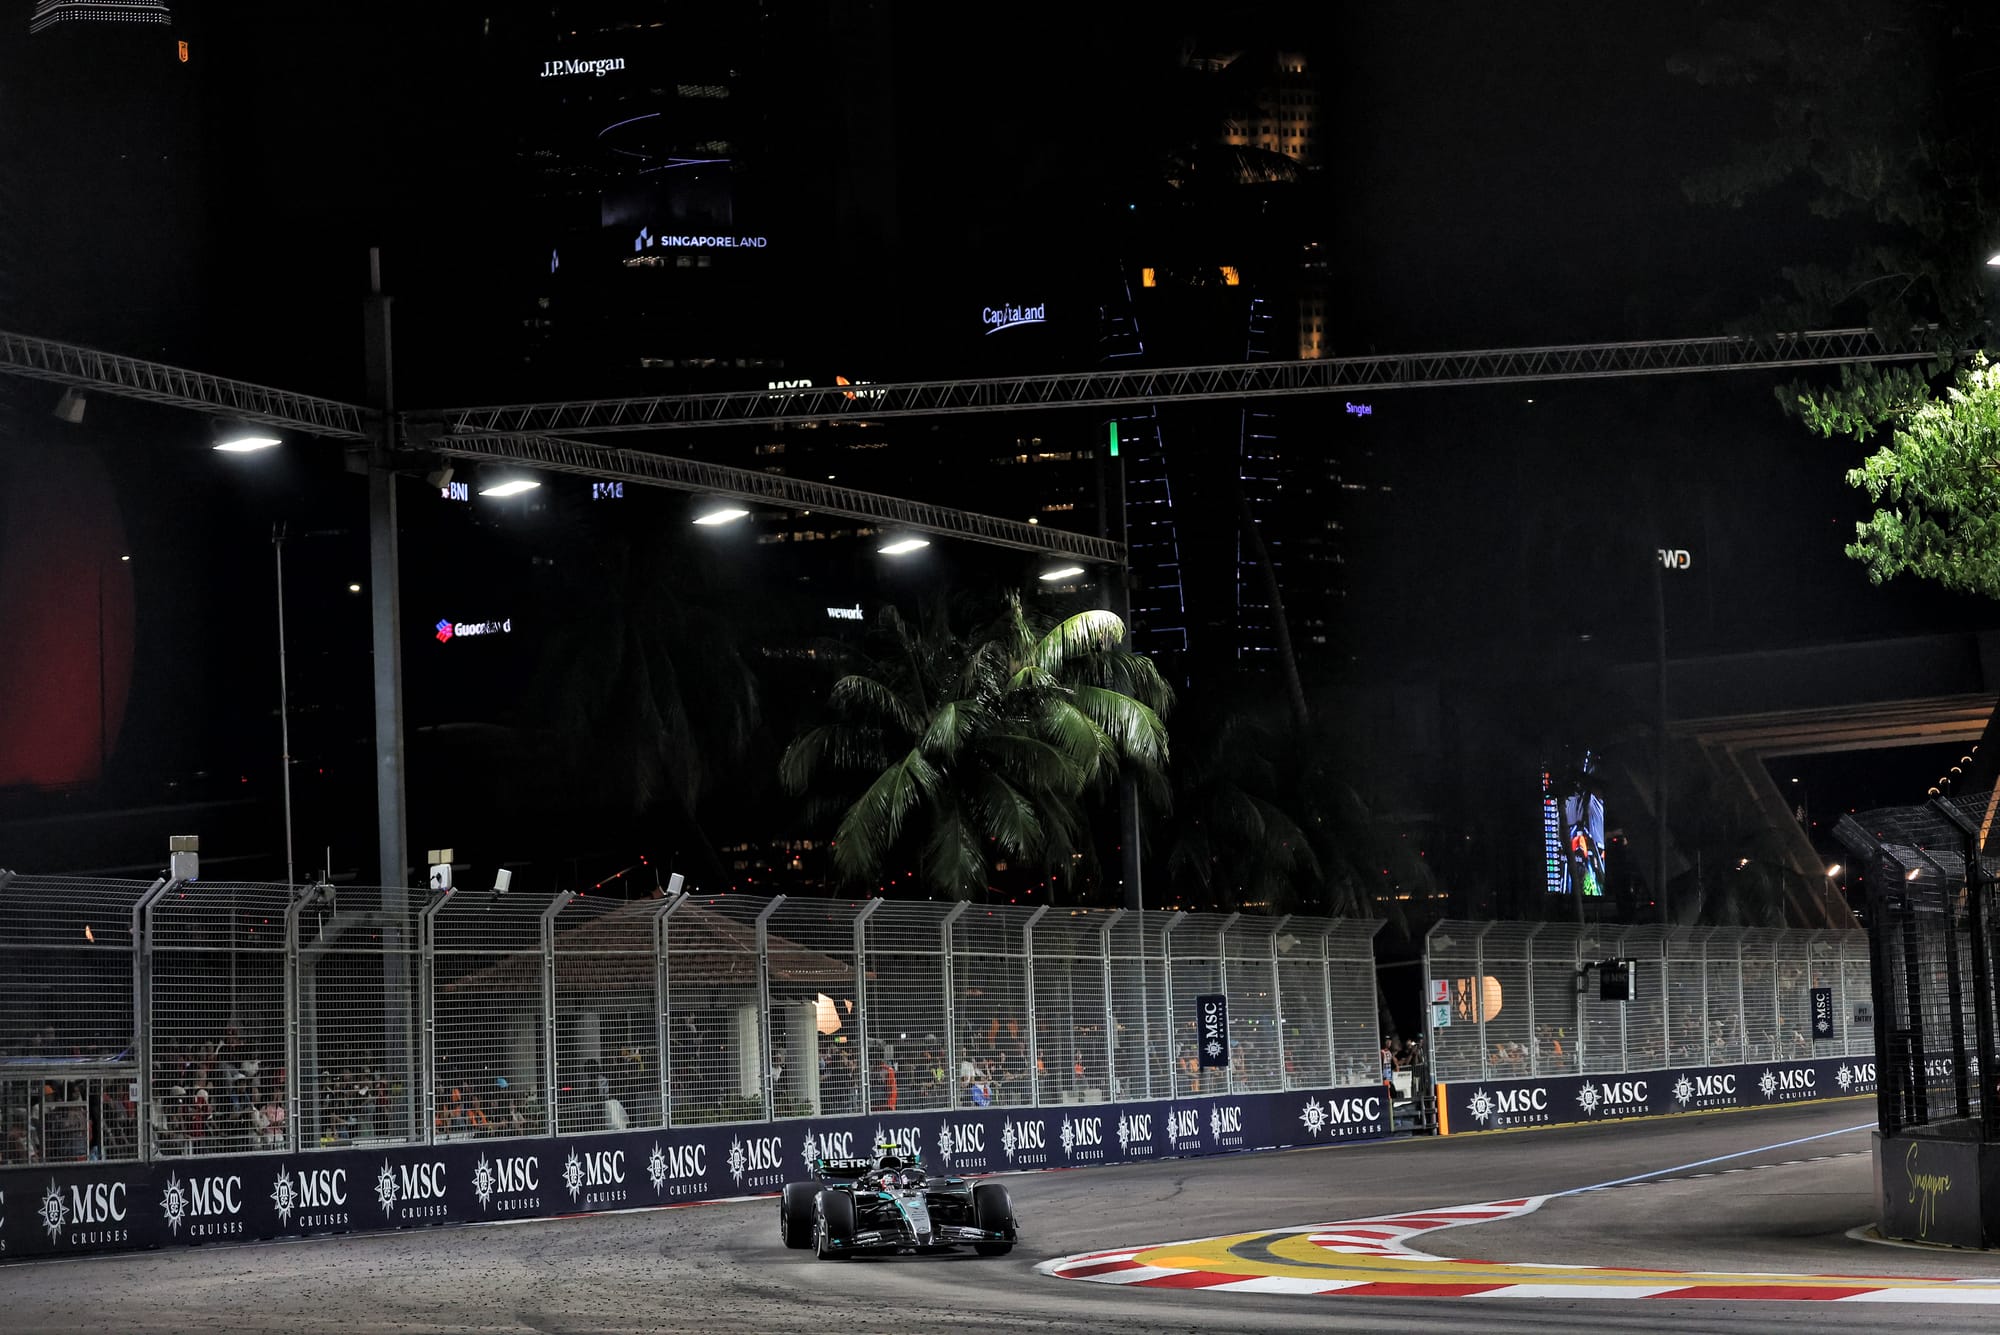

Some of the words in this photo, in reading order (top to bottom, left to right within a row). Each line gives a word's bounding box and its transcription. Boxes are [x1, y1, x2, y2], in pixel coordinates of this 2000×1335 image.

[540, 58, 625, 77] J.P.Morgan
[983, 303, 1045, 327] CapitaLand
[1346, 402, 1372, 417] Singtel
[450, 482, 468, 501] BNI
[827, 603, 864, 620] wework
[1816, 993, 1826, 1019] MSC
[1858, 1007, 1867, 1015] PIT
[1204, 1003, 1218, 1039] MSC
[1854, 1015, 1873, 1023] ENTRY
[1779, 1069, 1815, 1089] MSC
[1854, 1064, 1875, 1083] MS
[1602, 1081, 1647, 1104] MSC
[1696, 1075, 1735, 1096] MSC
[1779, 1090, 1816, 1100] CRUISES
[1329, 1097, 1380, 1124] MSC
[1496, 1088, 1547, 1113] MSC
[1697, 1097, 1737, 1107] CRUISES
[1221, 1107, 1241, 1132] MSC
[1497, 1114, 1549, 1125] CRUISES
[1603, 1106, 1649, 1116] CRUISES
[1075, 1117, 1102, 1145] MSC
[1129, 1114, 1151, 1141] MSC
[1178, 1110, 1198, 1136] MSC
[1331, 1125, 1381, 1136] CRUISES
[954, 1123, 984, 1152] MSC
[1017, 1120, 1045, 1149] MSC
[668, 1144, 706, 1178] MSC
[747, 1137, 782, 1170] MSC
[956, 1158, 986, 1168] CRUISES
[1019, 1155, 1046, 1163] CRUISES
[496, 1157, 538, 1192] MSC
[585, 1151, 625, 1185] MSC
[298, 1169, 346, 1207] MSC
[401, 1162, 446, 1200] MSC
[670, 1183, 707, 1195] CRUISES
[749, 1174, 783, 1186] CRUISES
[1906, 1142, 1952, 1238] Singapore
[71, 1182, 126, 1223] MSC
[190, 1176, 241, 1216] MSC
[498, 1198, 539, 1210] CRUISES
[587, 1191, 626, 1203] CRUISES
[300, 1213, 348, 1227] CRUISES
[402, 1205, 447, 1218] CRUISES
[72, 1230, 127, 1244] CRUISES
[191, 1222, 242, 1235] CRUISES
